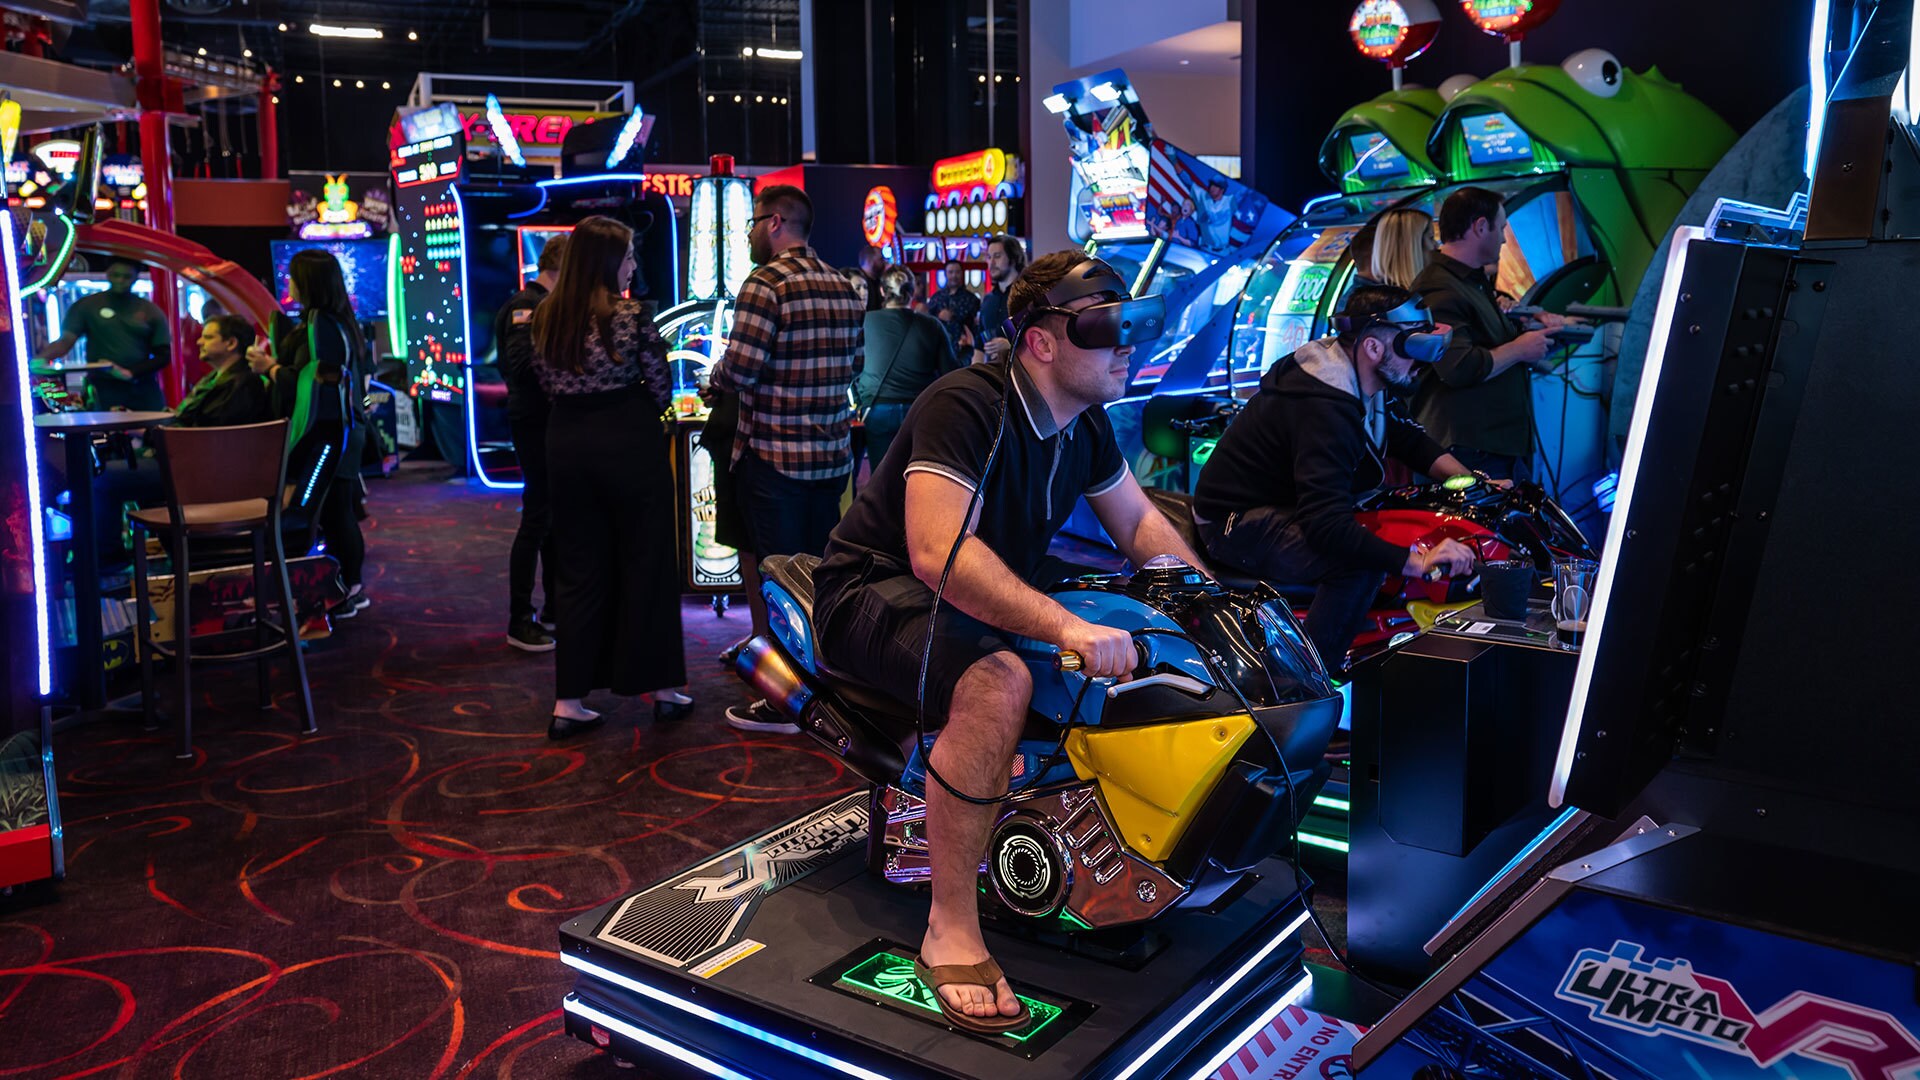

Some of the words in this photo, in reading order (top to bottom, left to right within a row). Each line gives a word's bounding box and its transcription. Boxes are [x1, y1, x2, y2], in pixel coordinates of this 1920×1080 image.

[1570, 962, 1722, 1016] ULTRA
[1310, 1026, 1340, 1046] NO
[1606, 994, 1750, 1043] MOTO
[1268, 1045, 1320, 1080] ENTR
